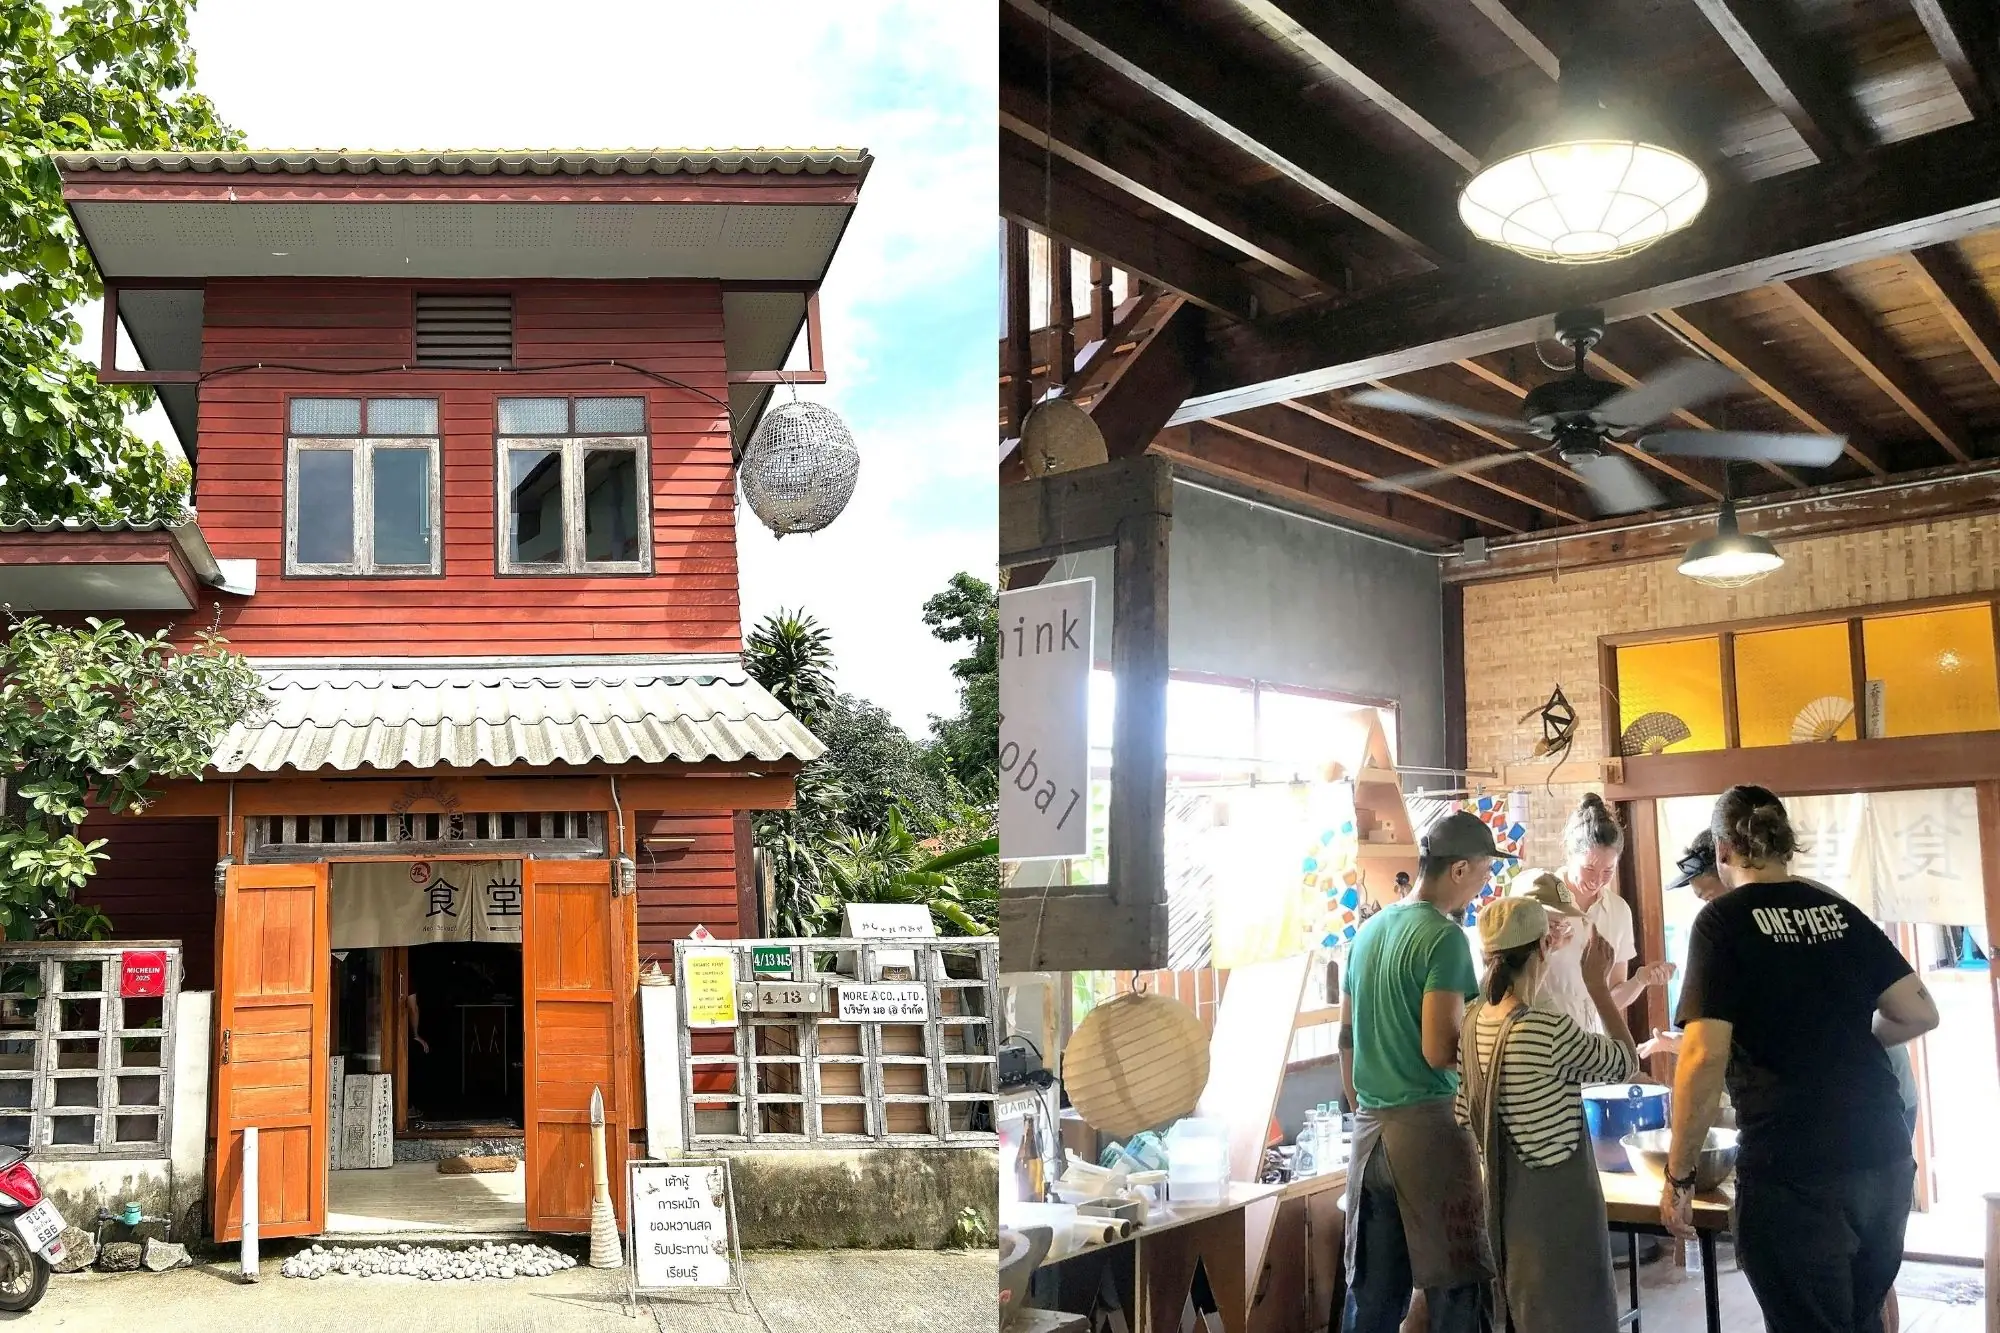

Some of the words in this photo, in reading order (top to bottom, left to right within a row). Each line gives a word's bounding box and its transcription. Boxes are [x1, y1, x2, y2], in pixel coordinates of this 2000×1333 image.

[998, 711, 1081, 831] obal
[424, 877, 522, 918] 食堂
[1752, 907, 1796, 935] ONE
[1792, 904, 1849, 936] PIECE
[754, 951, 775, 967] 4/13
[135, 974, 151, 982] 2025
[762, 990, 802, 1005] 4/13
[843, 991, 869, 1001] MORE
[843, 1004, 870, 1015] บริษัท
[873, 1006, 886, 1015] มอ
[900, 1004, 924, 1015] จำกัด
[665, 1174, 690, 1191] เต้าหู้
[658, 1197, 700, 1210] การหมัก
[650, 1221, 712, 1232] ของหวานสด
[654, 1243, 708, 1255] รับประทาน
[666, 1265, 698, 1282] เรียนรู้
